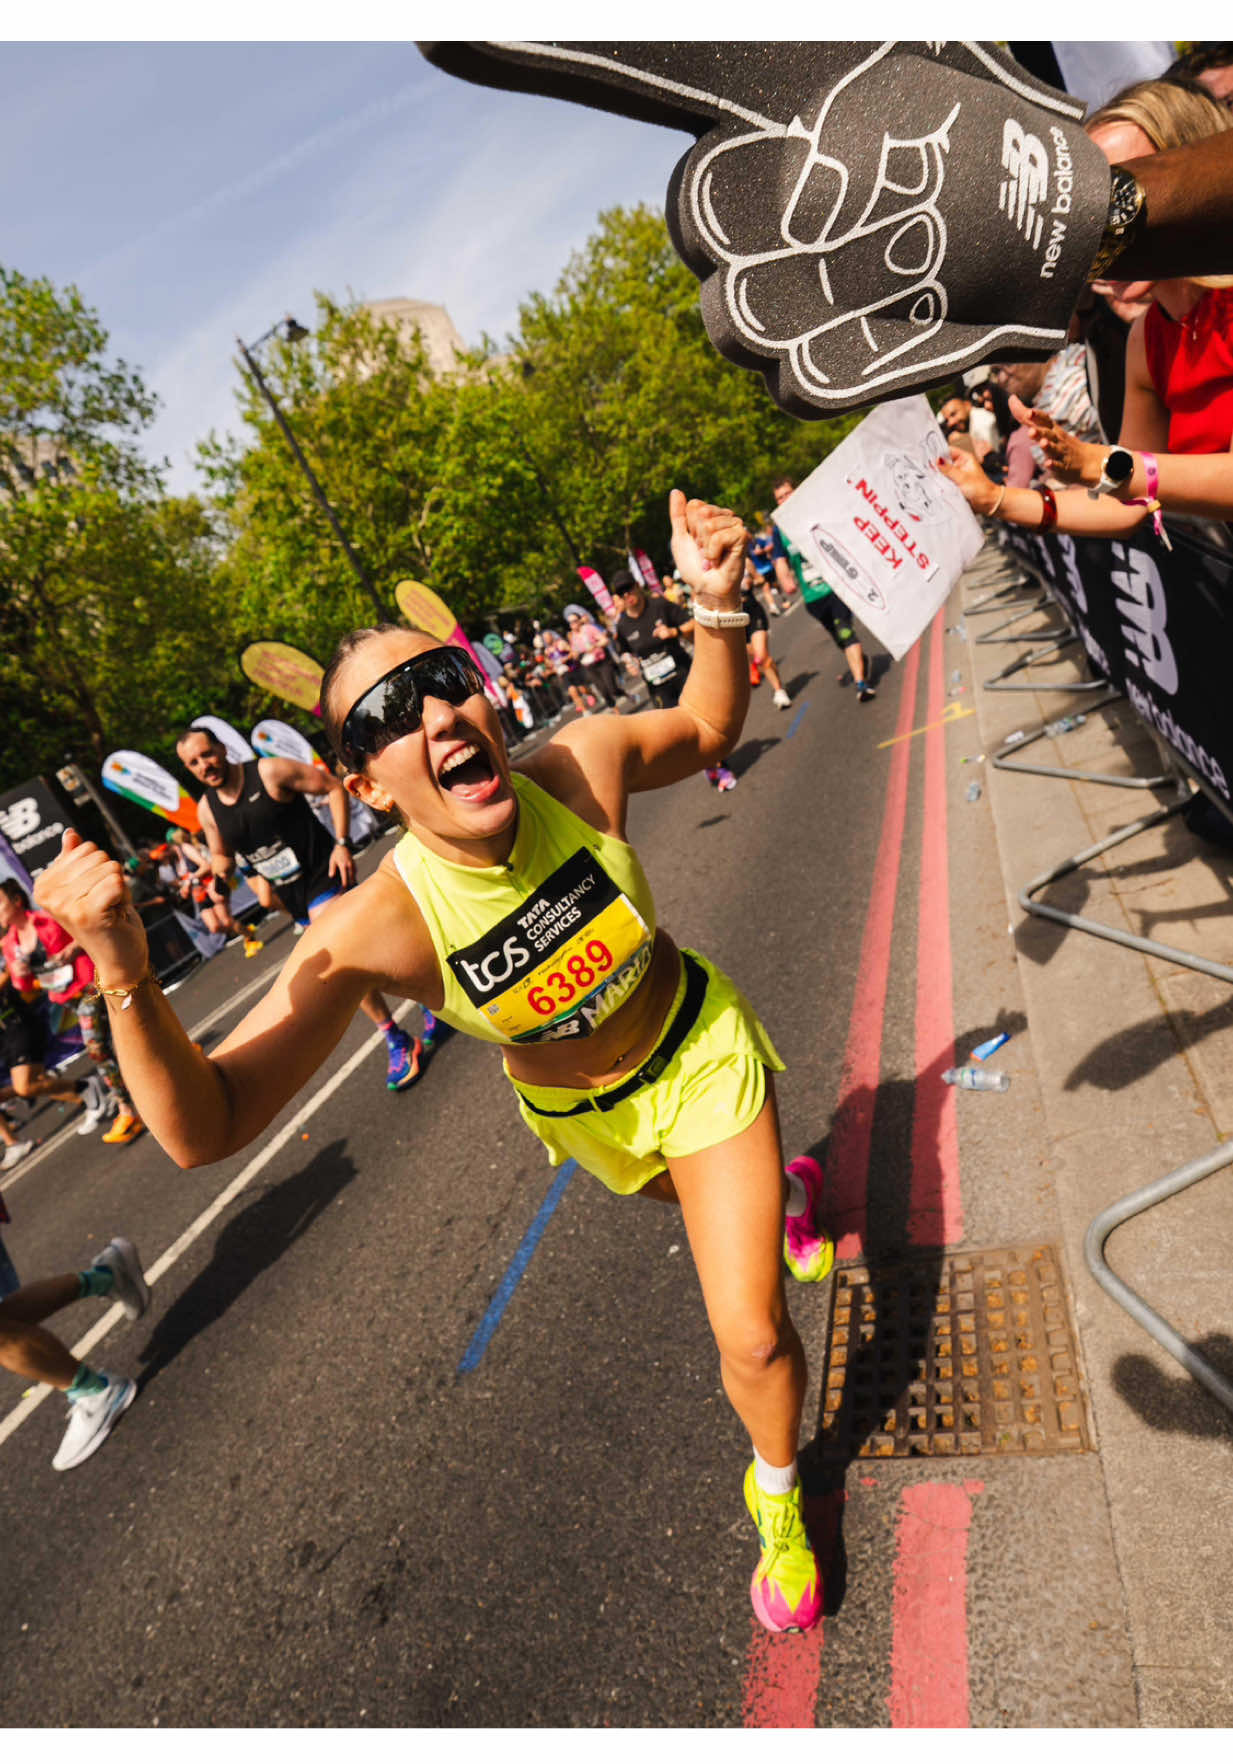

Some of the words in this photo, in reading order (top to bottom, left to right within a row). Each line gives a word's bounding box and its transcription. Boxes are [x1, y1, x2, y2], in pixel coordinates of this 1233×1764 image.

[1050, 126, 1073, 214] balance
[1040, 219, 1067, 278] new
[853, 516, 903, 569] KEEP
[517, 898, 550, 929] TATA
[526, 874, 596, 941] CONSULTANCY
[534, 906, 582, 952] SERVICES
[460, 936, 530, 993] tcs
[527, 939, 614, 1016] 6389
